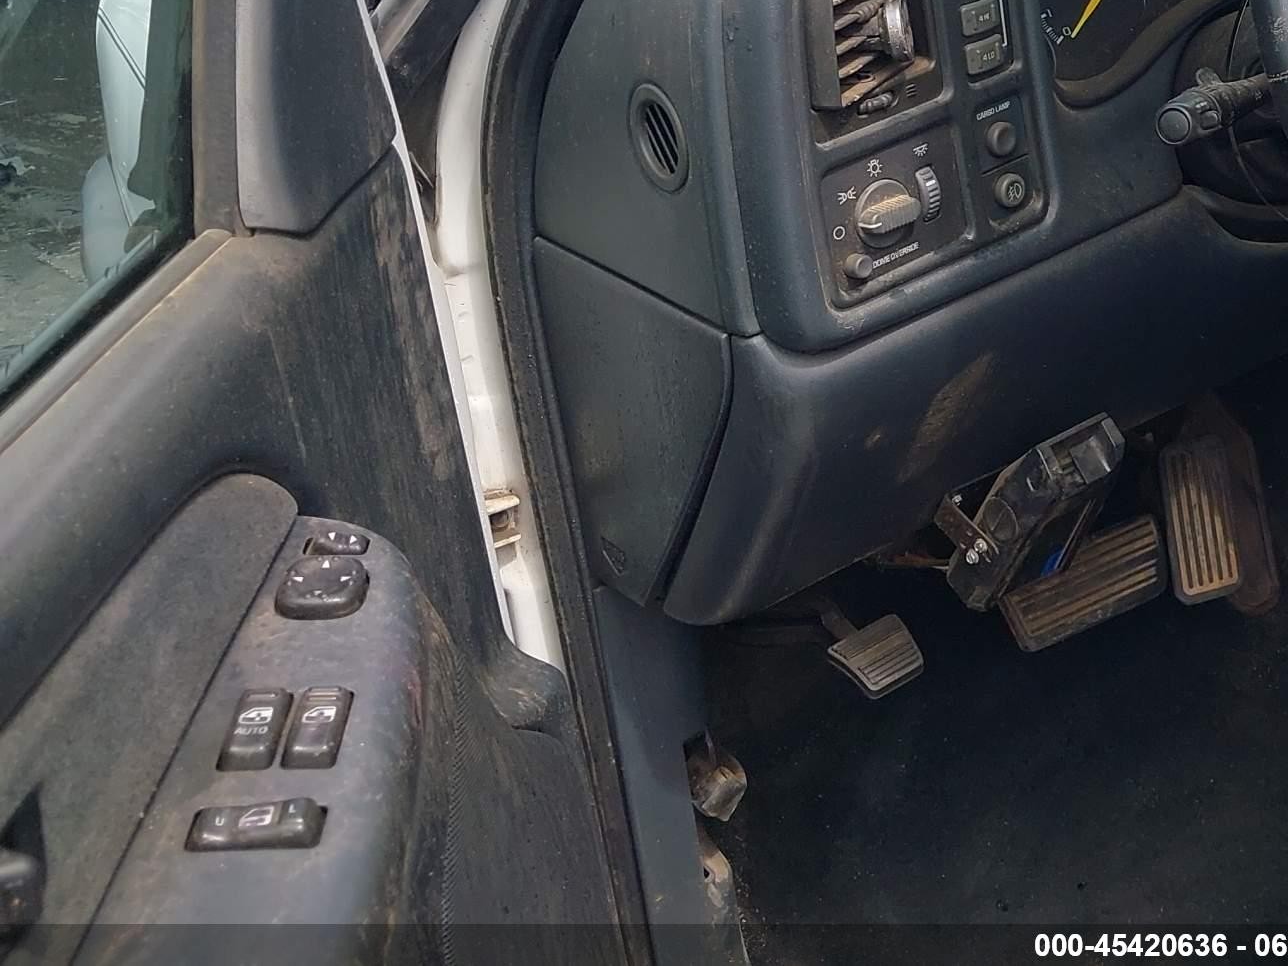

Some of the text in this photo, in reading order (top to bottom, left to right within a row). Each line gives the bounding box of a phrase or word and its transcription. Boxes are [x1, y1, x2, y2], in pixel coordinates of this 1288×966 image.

[1062, 26, 1071, 36] 0
[976, 100, 1010, 121] CARGO LAMP
[872, 241, 919, 269] DOME OVERRIDE
[234, 725, 269, 735] AUTO
